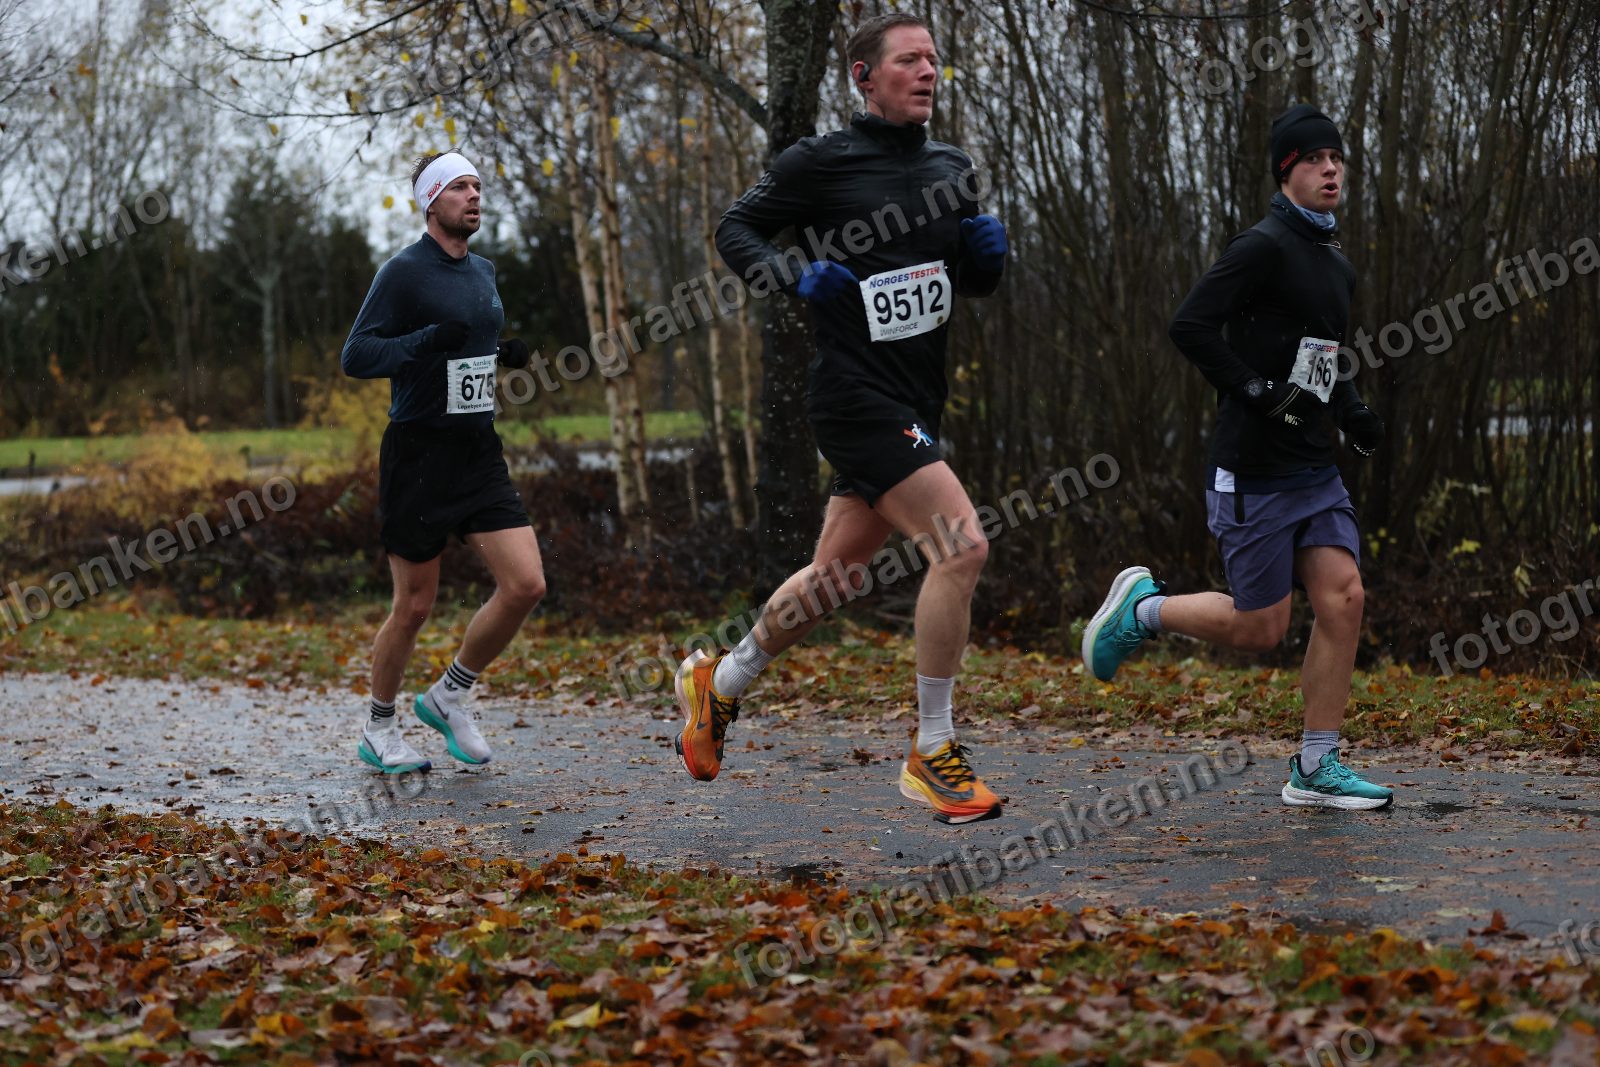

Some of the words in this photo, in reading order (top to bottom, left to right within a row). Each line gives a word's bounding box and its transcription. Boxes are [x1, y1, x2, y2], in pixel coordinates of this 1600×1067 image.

[869, 266, 940, 289] NORGESTESTEN
[873, 280, 944, 325] 9512
[880, 322, 919, 336] WINFORCE
[461, 372, 494, 402] 675
